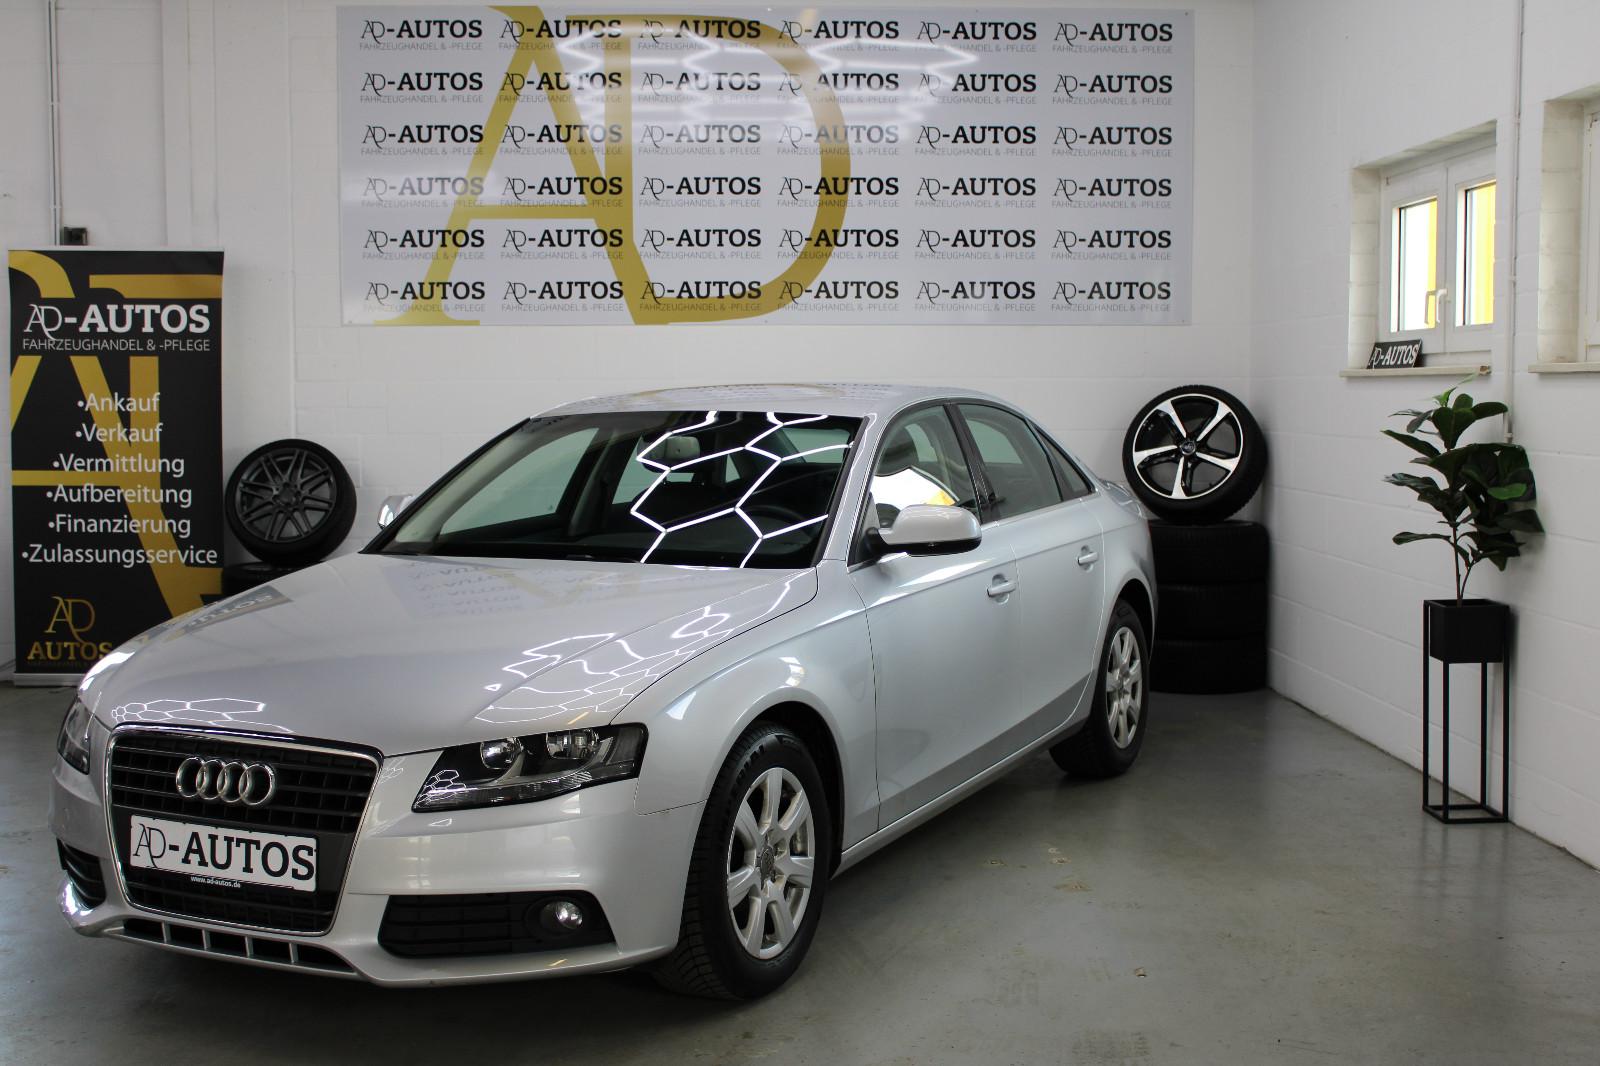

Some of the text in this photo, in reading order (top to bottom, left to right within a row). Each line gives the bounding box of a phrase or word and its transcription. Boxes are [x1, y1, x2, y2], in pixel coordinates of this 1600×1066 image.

[361, 20, 482, 44] AD-AUTOS
[779, 20, 899, 44] AD-AUTOS
[917, 21, 1037, 45] AD-AUTOS
[1054, 22, 1173, 47] AD-AUTOS
[362, 73, 483, 97] AD-AUTOS
[640, 72, 761, 96] AD-AUTOS
[1054, 74, 1172, 99] AD-AUTOS
[362, 125, 484, 149] AD-AUTOS
[501, 125, 622, 149] AD-AUTOS
[640, 124, 761, 148] AD-AUTOS
[779, 125, 899, 149] AD-AUTOS
[916, 125, 1036, 149] AD-AUTOS
[1053, 126, 1172, 150] AD-AUTOS
[363, 177, 484, 201] AD-AUTOS
[502, 177, 623, 201] AD-AUTOS
[640, 177, 761, 201] AD-AUTOS
[779, 177, 899, 201] AD-AUTOS
[916, 177, 1036, 201] AD-AUTOS
[1053, 178, 1171, 202] AD-AUTOS
[364, 230, 485, 254] AD-AUTOS
[502, 229, 623, 253] AD-AUTOS
[641, 229, 761, 253] AD-AUTOS
[779, 229, 899, 253] AD-AUTOS
[916, 229, 1036, 253] AD-AUTOS
[1053, 230, 1171, 254] AD-AUTOS
[365, 282, 485, 306] AD-AUTOS
[503, 281, 623, 305] AD-AUTOS
[641, 281, 761, 305] AD-AUTOS
[779, 281, 899, 305] AD-AUTOS
[916, 281, 1035, 305] AD-AUTOS
[1053, 281, 1171, 305] AD-AUTOS
[24, 304, 210, 340] AD-AUTOS
[22, 339, 210, 351] FAHRZEUGHANDEL & -PFLEGE
[44, 596, 96, 644] AD
[27, 641, 112, 660] AUTOS
[133, 823, 315, 881] AD-AUTOS
[190, 876, 241, 888] www.ad-autos.de
